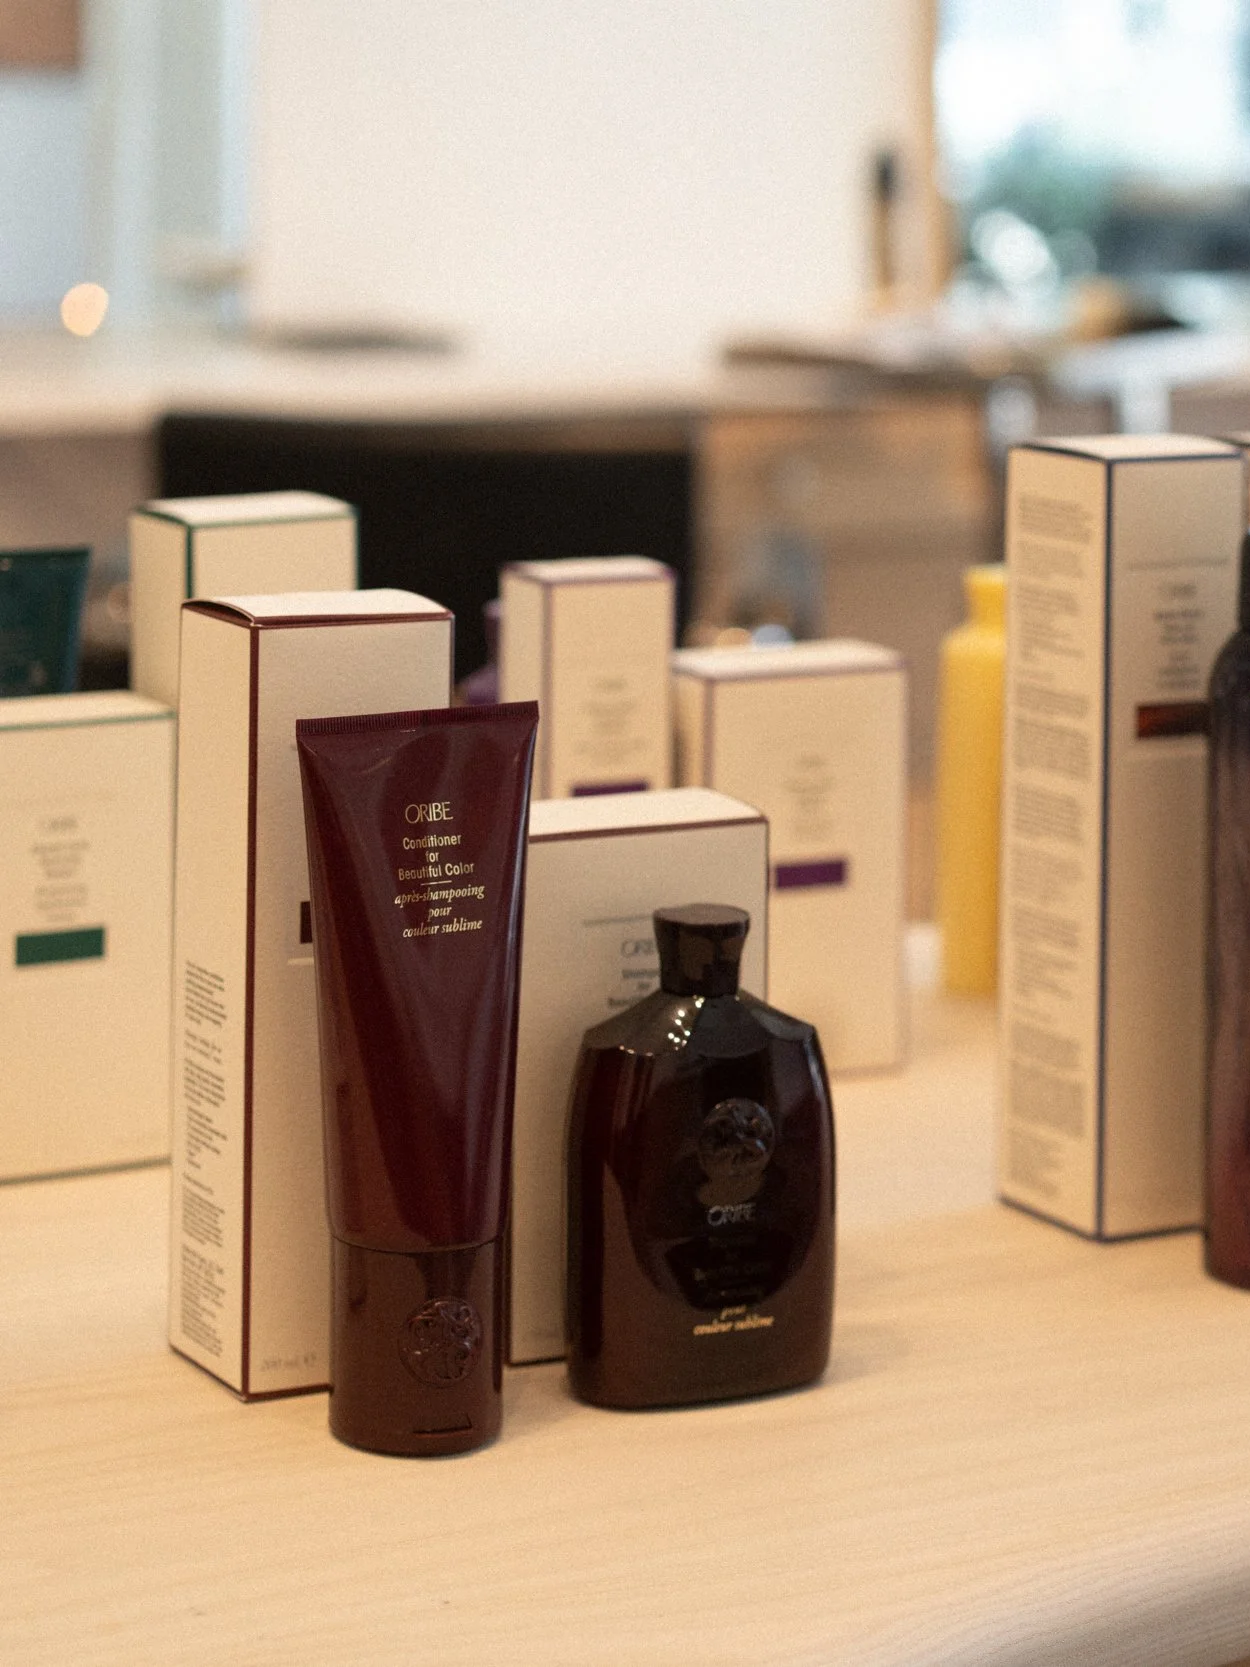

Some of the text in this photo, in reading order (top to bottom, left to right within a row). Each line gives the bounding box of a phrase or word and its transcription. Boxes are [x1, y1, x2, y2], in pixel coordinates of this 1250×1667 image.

[405, 802, 454, 824] ORIBE
[402, 834, 462, 850] Conditioner
[425, 851, 439, 863] for
[398, 862, 475, 881] Beautiful Color
[394, 884, 485, 908] après-shampooing
[427, 906, 452, 922] pour
[402, 918, 483, 938] couleur sublime
